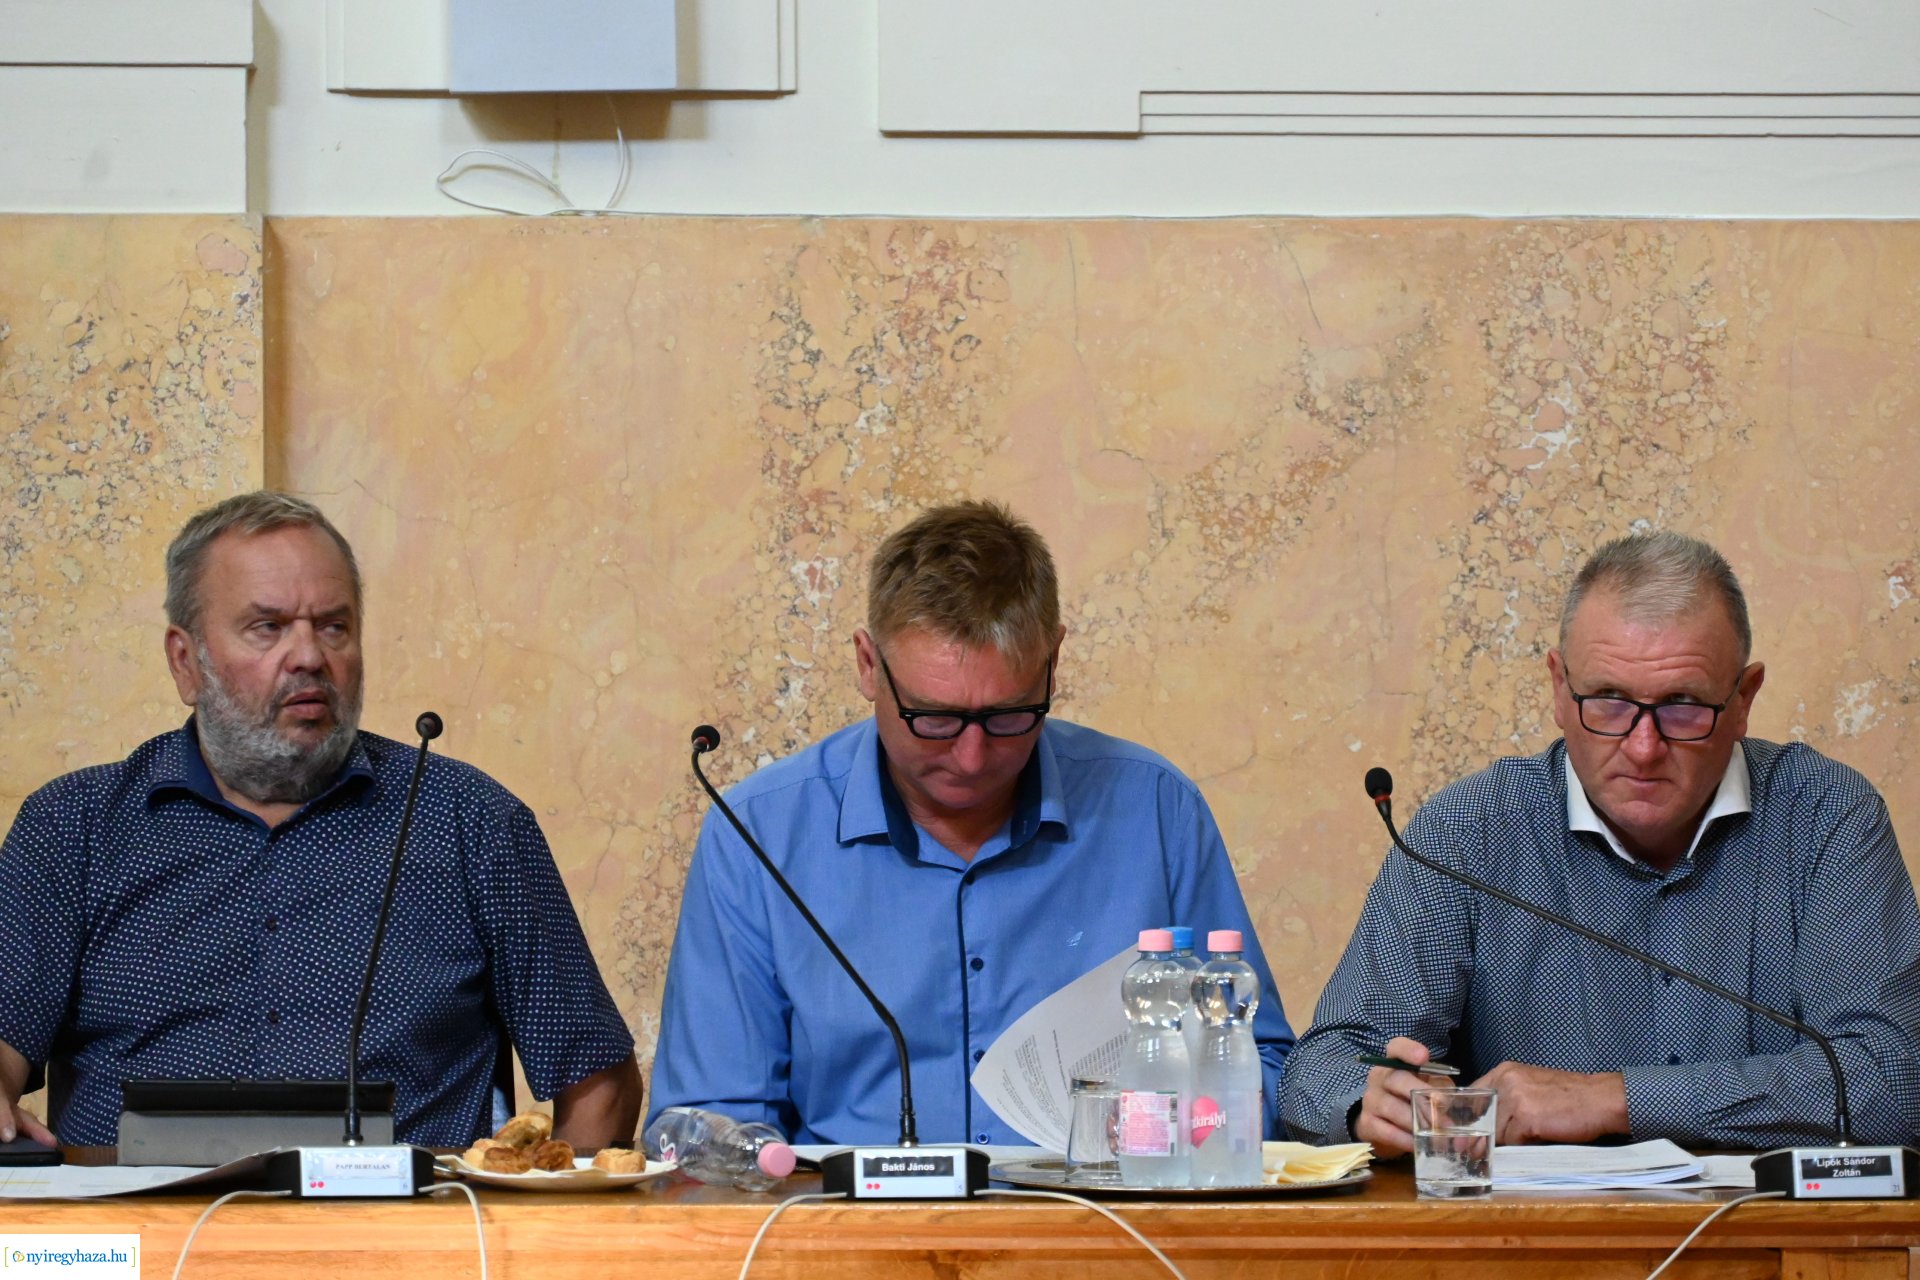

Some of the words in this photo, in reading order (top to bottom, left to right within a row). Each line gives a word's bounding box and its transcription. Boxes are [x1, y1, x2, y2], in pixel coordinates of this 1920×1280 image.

[1843, 1156, 1876, 1166] Sándor
[881, 1163, 906, 1172] Bakti
[907, 1162, 935, 1171] János
[1832, 1168, 1861, 1178] Zoltán
